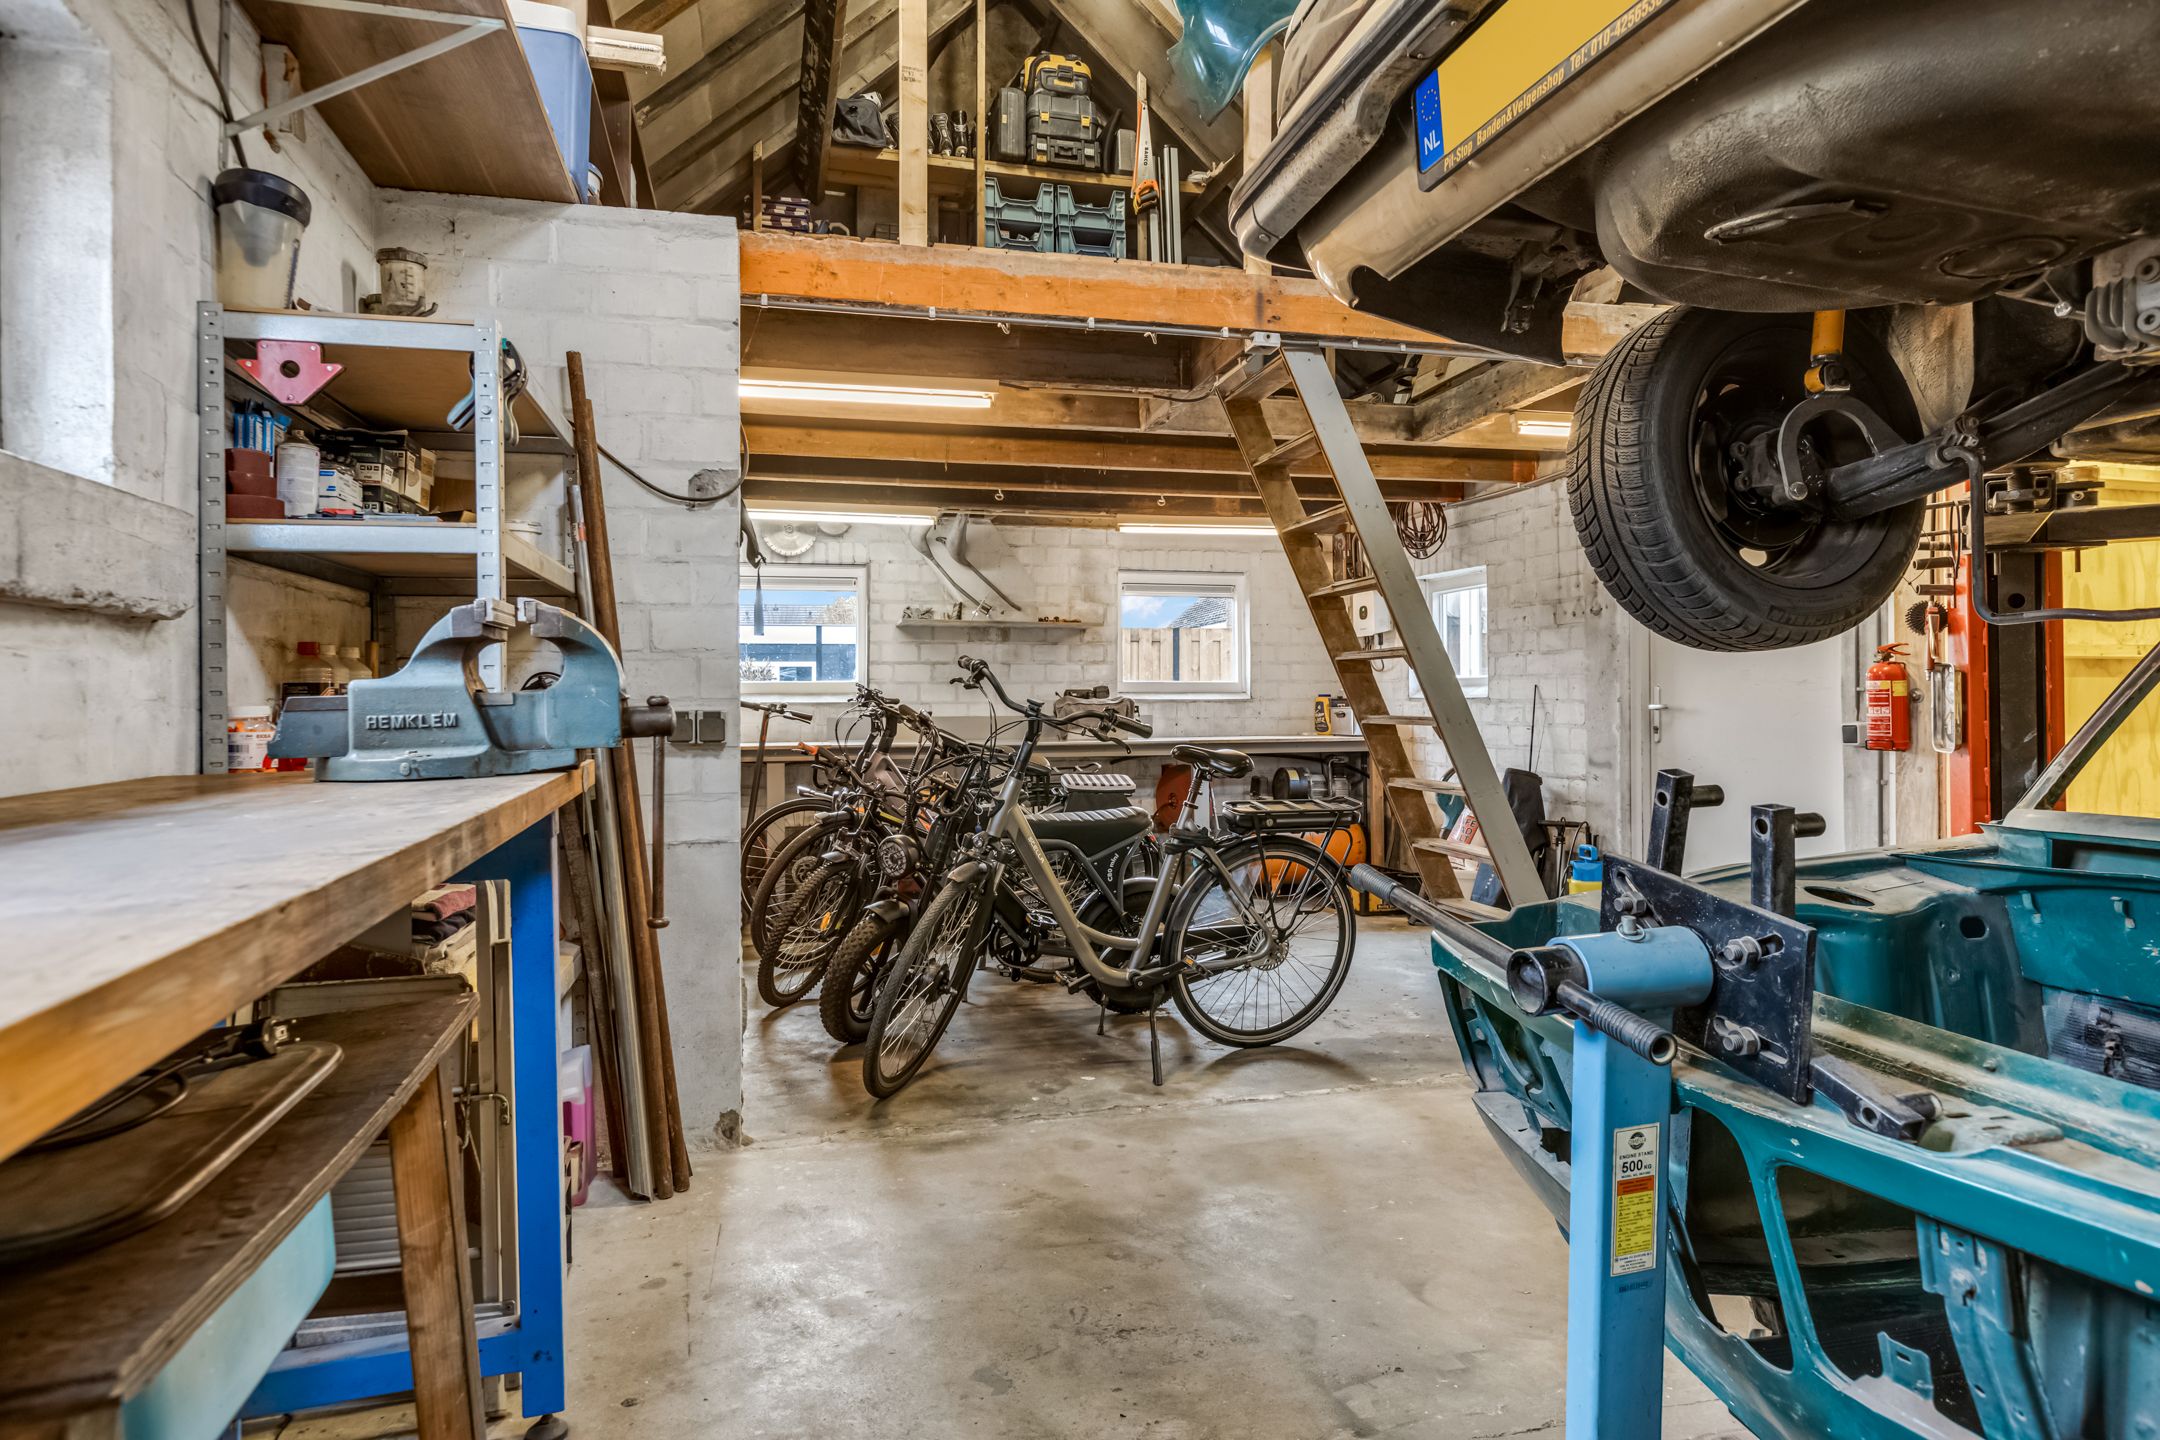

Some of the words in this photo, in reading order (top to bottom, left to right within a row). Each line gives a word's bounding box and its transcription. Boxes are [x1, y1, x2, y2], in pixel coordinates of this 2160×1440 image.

[1444, 141, 1473, 172] Pit-Stop
[1476, 67, 1565, 146] Banden&Velgenshop
[1423, 129, 1441, 155] NL
[1621, 1159, 1643, 1173] 500
